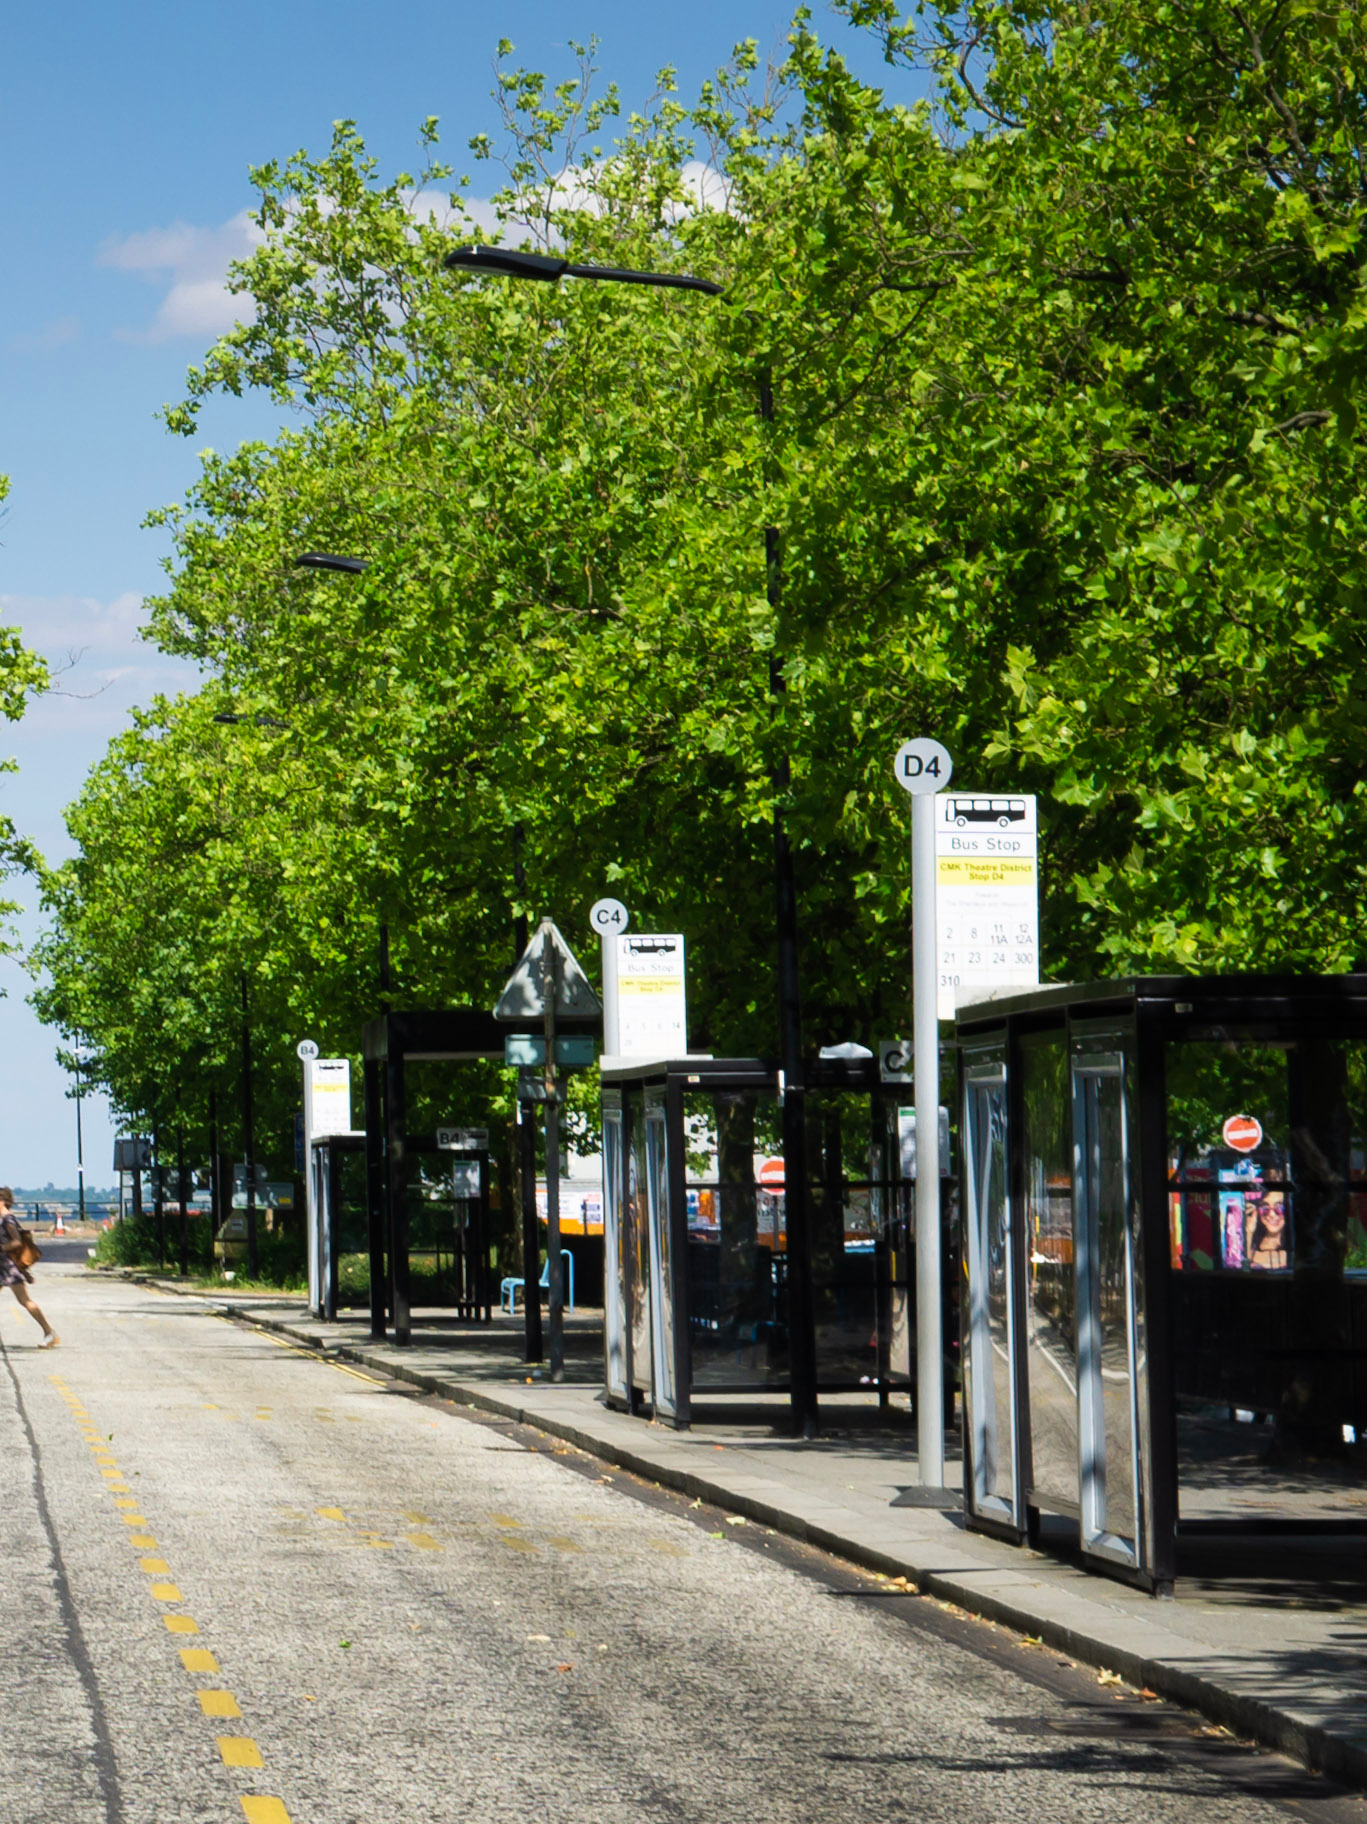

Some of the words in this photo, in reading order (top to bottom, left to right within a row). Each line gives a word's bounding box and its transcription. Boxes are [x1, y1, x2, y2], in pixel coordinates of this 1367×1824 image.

[903, 755, 941, 778] D4
[951, 837, 979, 851] Bus
[986, 837, 1021, 852] Stop
[939, 863, 961, 872] CMK
[964, 863, 998, 872] Theatre
[1000, 863, 1032, 872] District
[968, 872, 990, 882] Stop
[992, 872, 1004, 881] D4
[597, 909, 621, 925] C4
[945, 927, 953, 939] 2
[943, 951, 956, 964] 21
[967, 951, 982, 964] 23
[992, 951, 1006, 964] 24
[940, 975, 960, 987] 310
[300, 1045, 315, 1056] B4
[439, 1132, 460, 1144] B4
